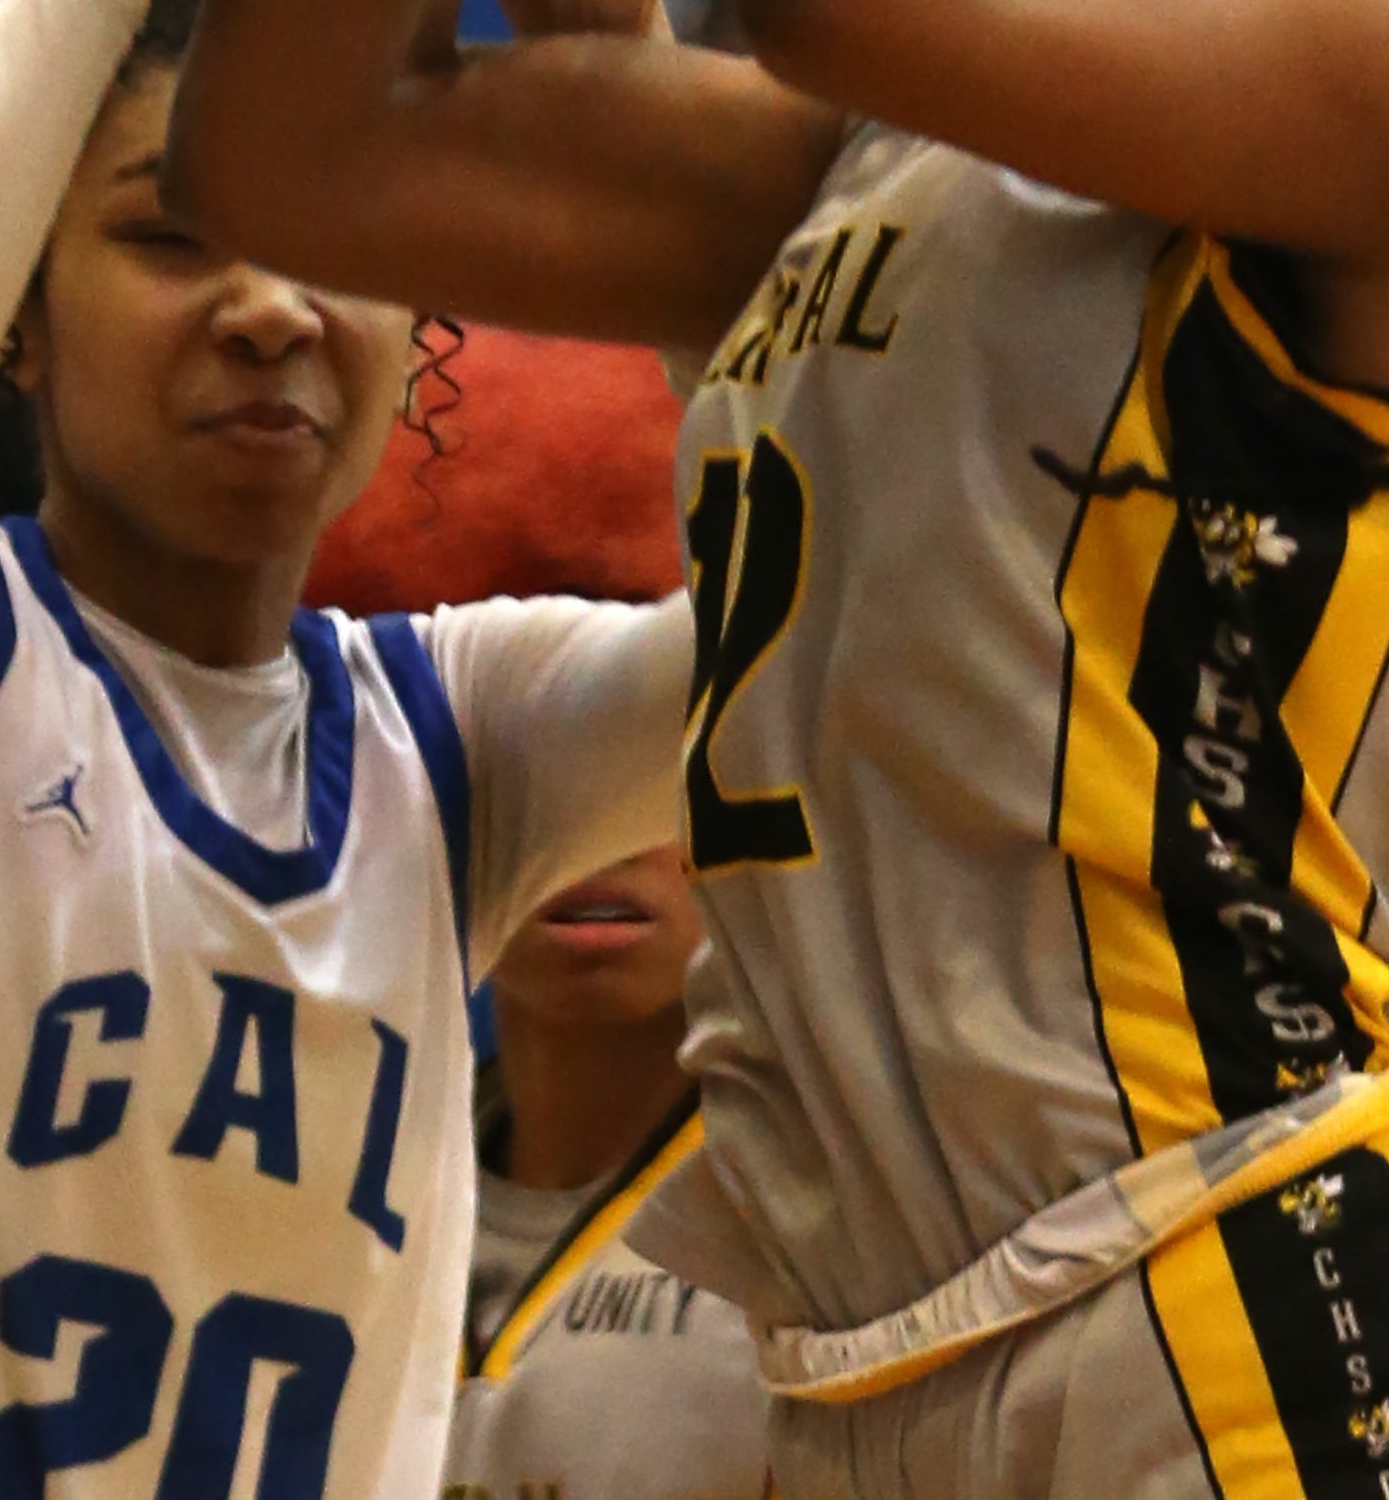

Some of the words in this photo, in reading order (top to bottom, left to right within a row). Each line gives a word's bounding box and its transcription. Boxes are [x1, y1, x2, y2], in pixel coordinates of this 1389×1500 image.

[5, 968, 409, 1255] CAL
[564, 1272, 697, 1335] UNITY
[1312, 1248, 1373, 1392] CHS
